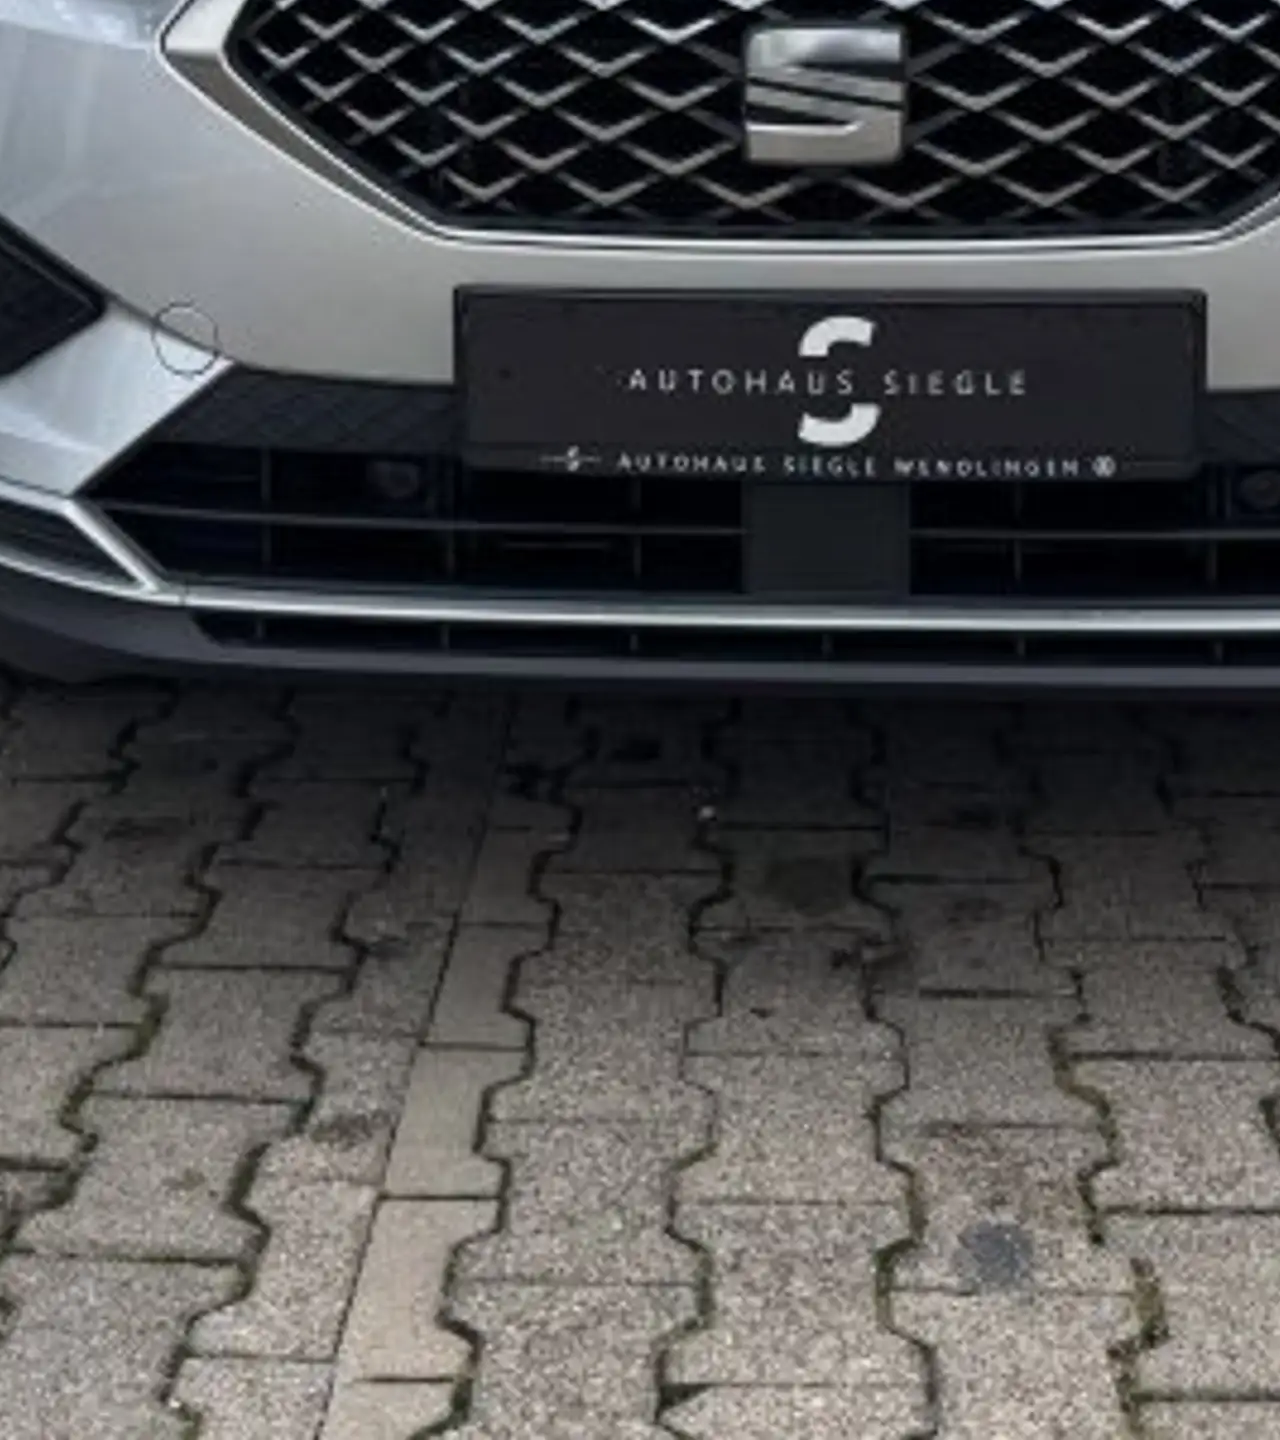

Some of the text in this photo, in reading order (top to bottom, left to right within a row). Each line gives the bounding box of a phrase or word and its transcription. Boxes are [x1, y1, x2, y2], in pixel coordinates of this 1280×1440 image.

[628, 368, 1028, 396] AUTOHAUS SIEGLE
[619, 452, 766, 474] AUTOHAUS
[782, 453, 875, 478] SIEGLE
[893, 456, 1078, 478] WENDLINGEN
